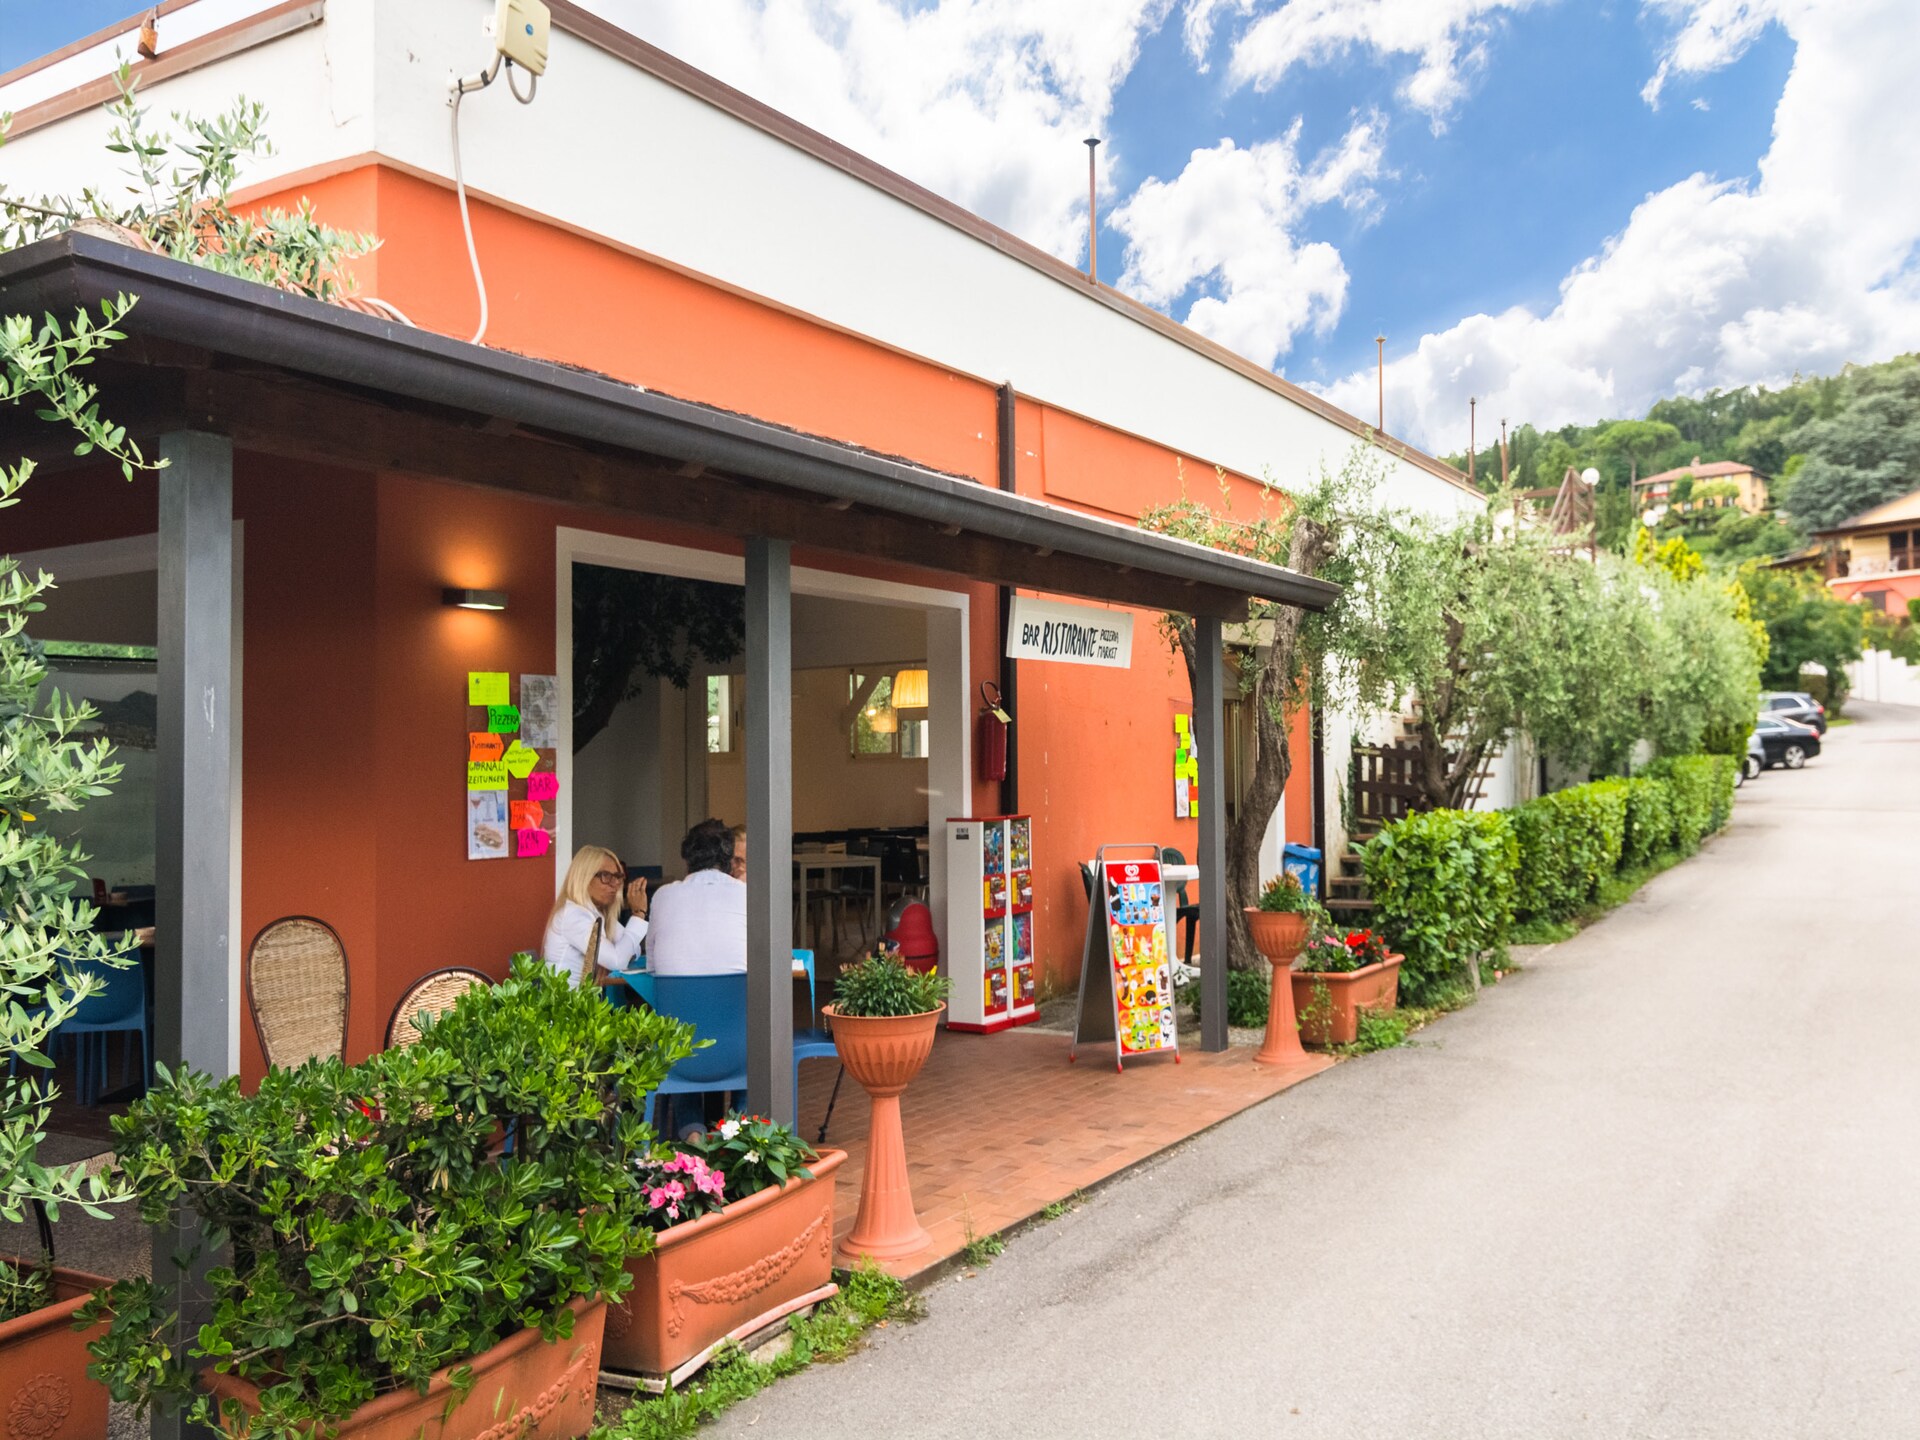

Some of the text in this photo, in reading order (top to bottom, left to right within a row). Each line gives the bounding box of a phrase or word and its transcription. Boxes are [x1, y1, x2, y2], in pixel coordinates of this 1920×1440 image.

[1022, 621, 1098, 657] BAR RISTORANTE
[1097, 645, 1117, 659] MARKET
[490, 708, 520, 725] PIZZERIA
[468, 775, 505, 784] ZEITUNGEN
[530, 776, 552, 793] BAR
